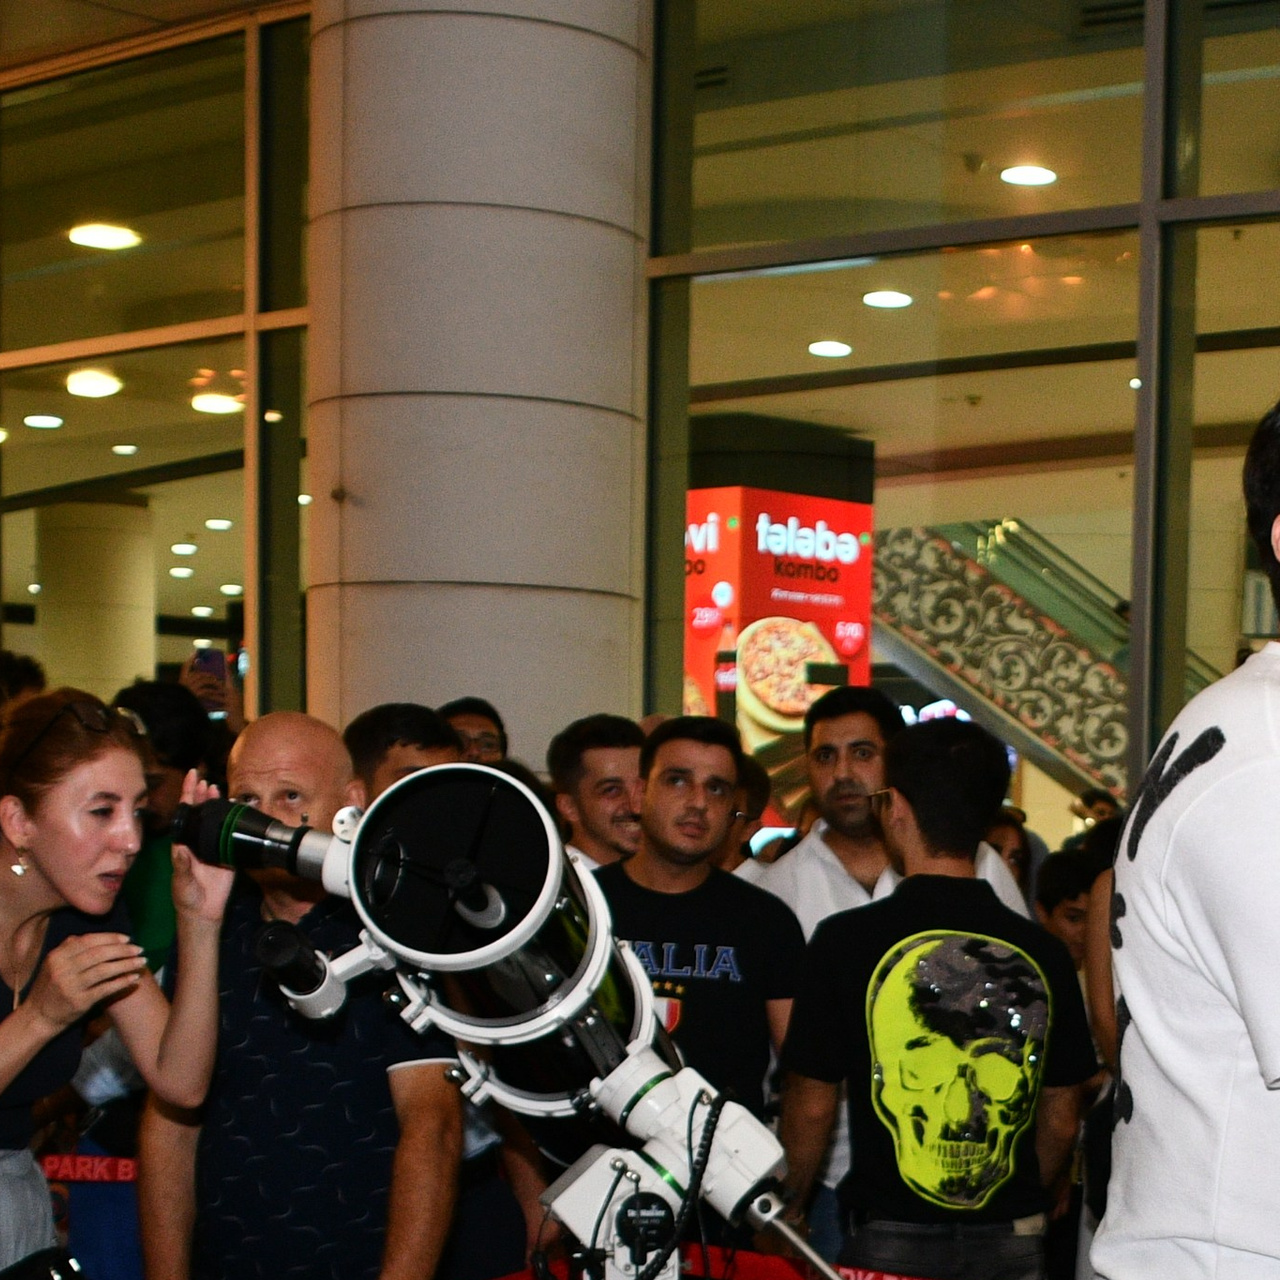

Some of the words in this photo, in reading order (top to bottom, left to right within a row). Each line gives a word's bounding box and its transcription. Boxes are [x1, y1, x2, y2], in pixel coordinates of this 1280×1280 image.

[774, 558, 841, 582] kombo
[630, 940, 742, 981] ALIA
[44, 1155, 111, 1179] PARK
